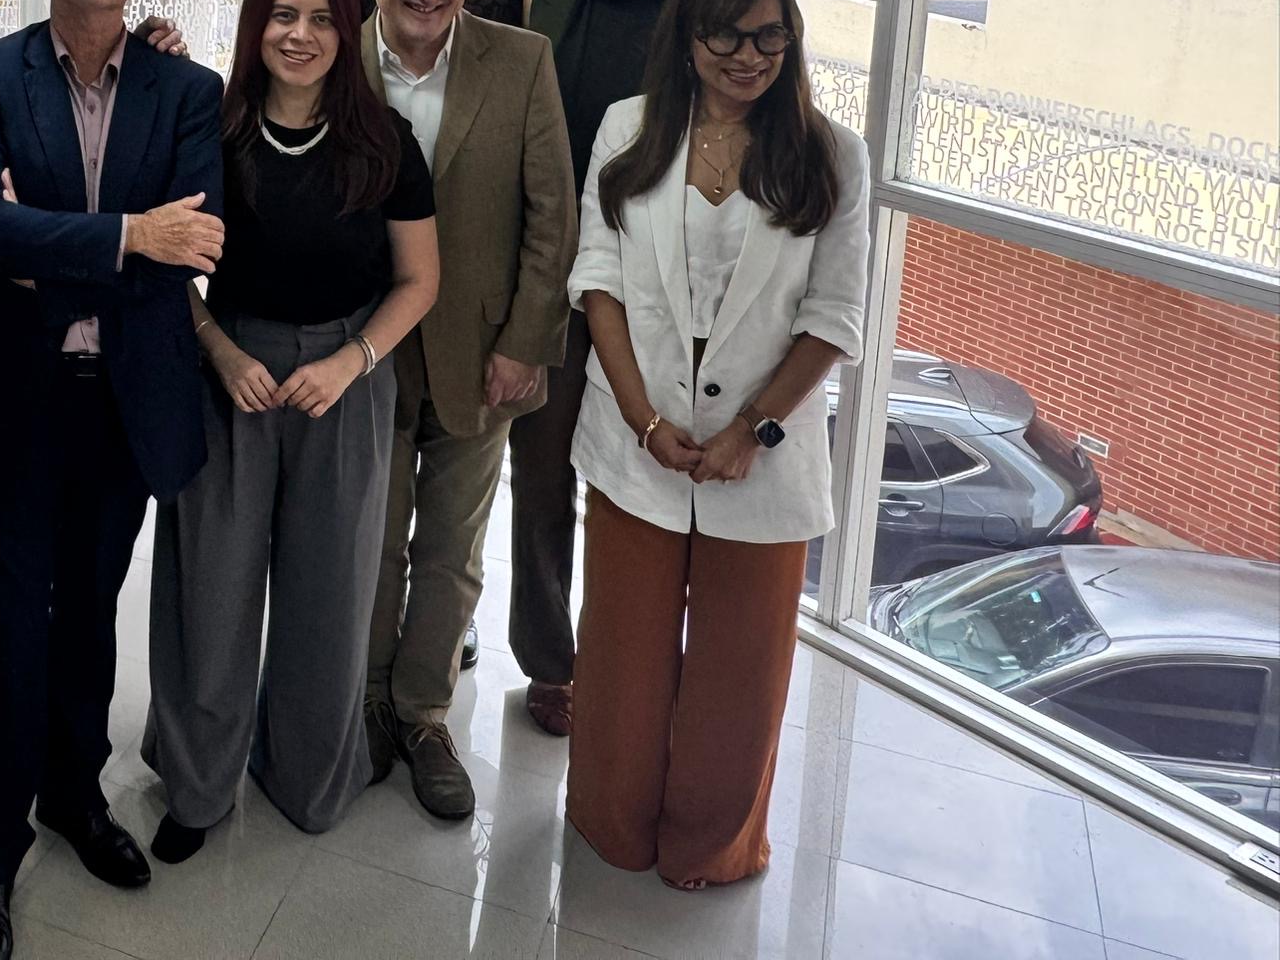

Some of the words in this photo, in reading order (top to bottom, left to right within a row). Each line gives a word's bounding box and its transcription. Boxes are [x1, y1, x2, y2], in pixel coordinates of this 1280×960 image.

[919, 109, 975, 137] WIRD
[982, 122, 1007, 143] ES
[1202, 167, 1267, 203] MAN
[932, 143, 971, 173] DER
[980, 158, 1067, 194] JUGEND
[970, 172, 1056, 211] HERZEN
[1154, 218, 1226, 254] NOCH
[1146, 175, 1199, 207] UND
[1209, 190, 1255, 220] WO
